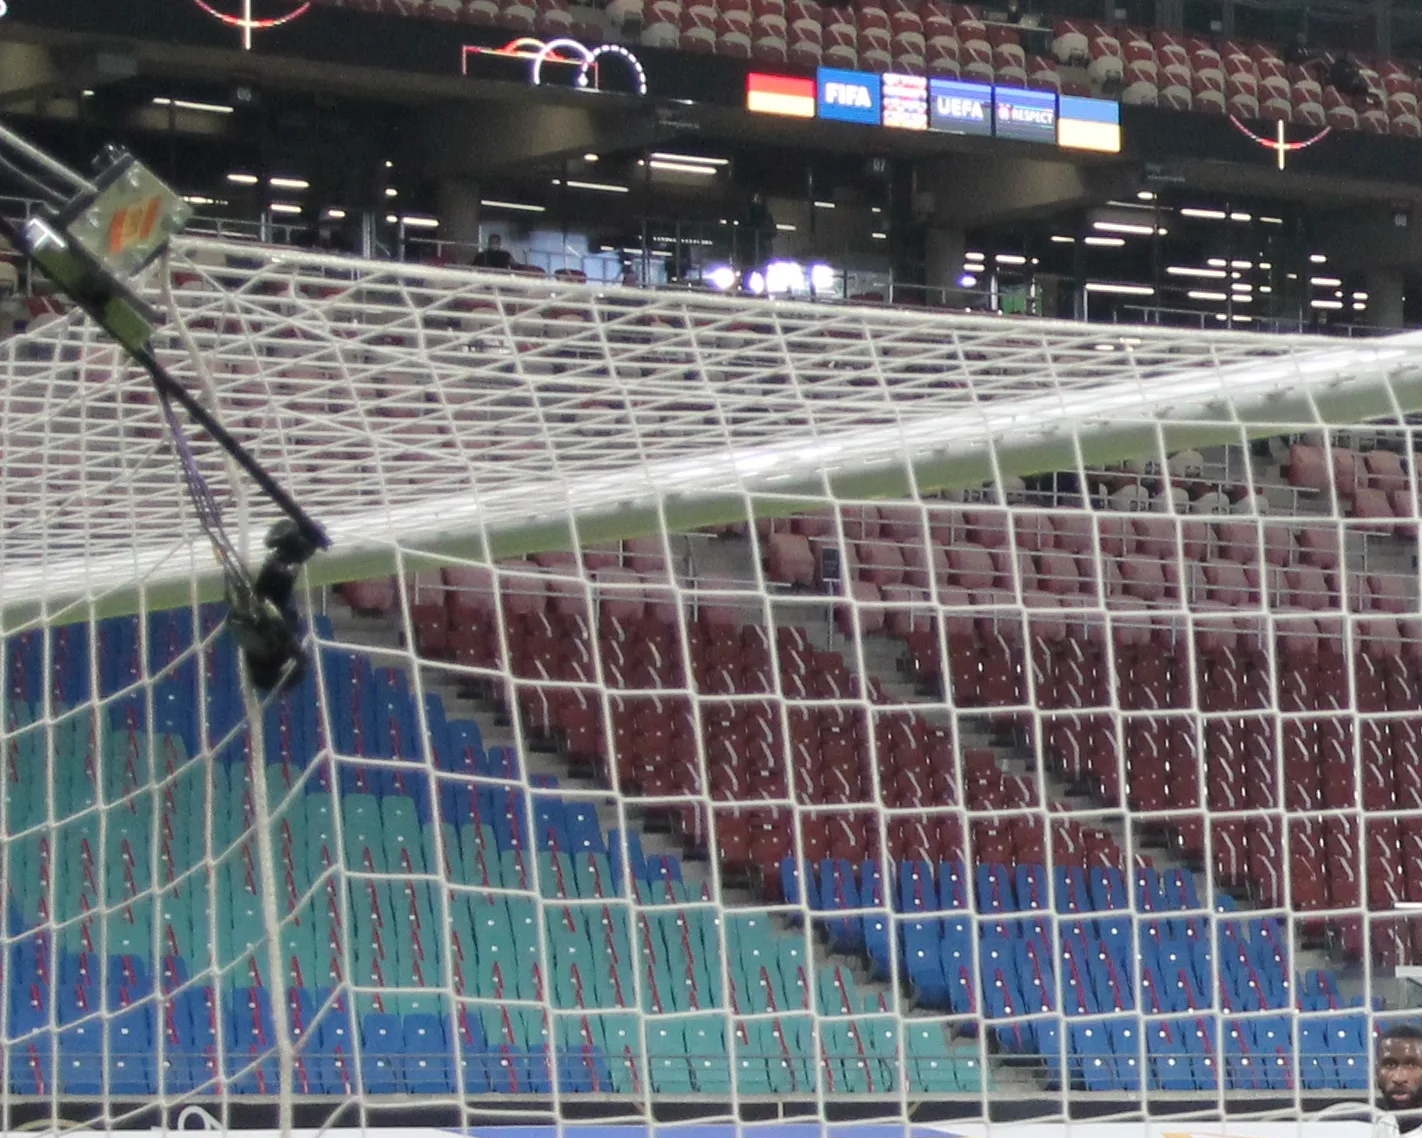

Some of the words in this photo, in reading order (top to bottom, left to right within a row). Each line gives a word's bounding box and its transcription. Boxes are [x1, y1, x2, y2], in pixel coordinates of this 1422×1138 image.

[825, 82, 872, 108] FIFA
[937, 96, 984, 121] UEFA
[1011, 109, 1054, 124] RESPECT
